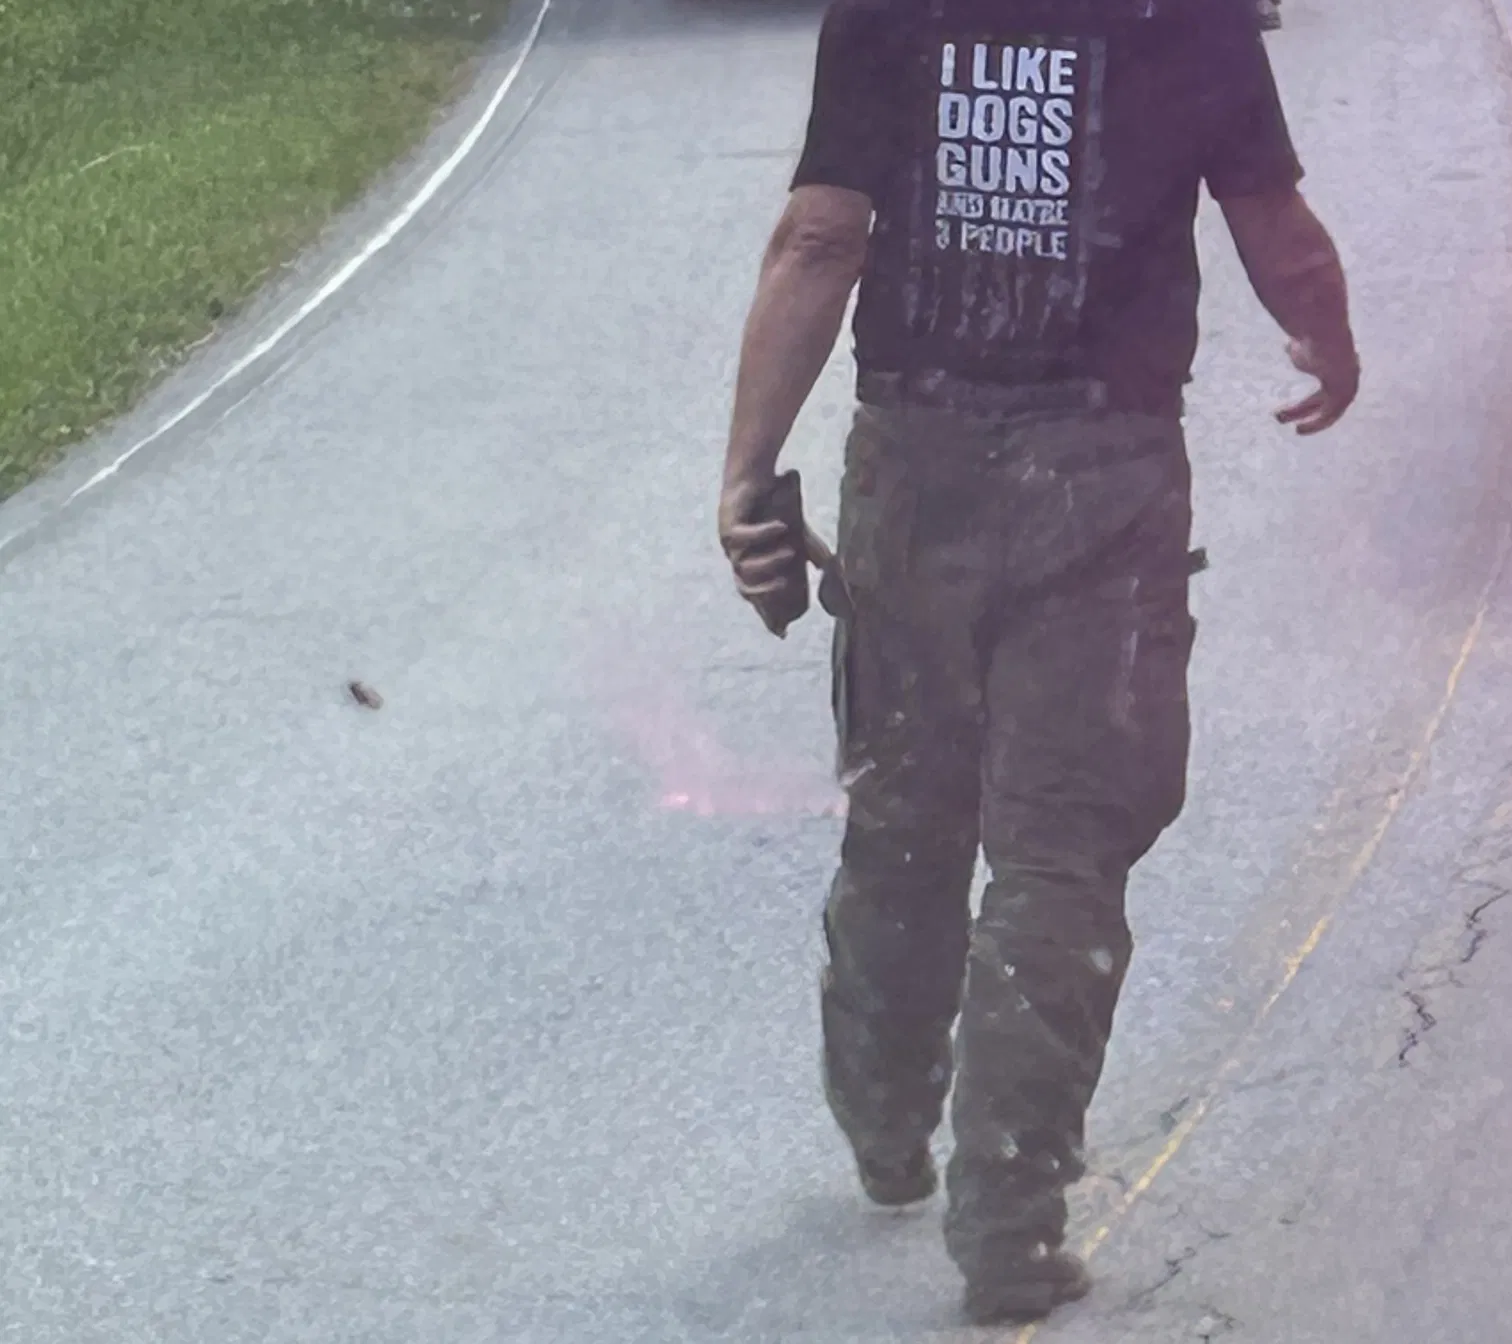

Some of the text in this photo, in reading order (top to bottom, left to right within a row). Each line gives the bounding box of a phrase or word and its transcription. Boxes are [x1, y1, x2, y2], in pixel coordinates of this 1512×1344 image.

[941, 43, 1077, 95] I LIKE
[938, 92, 1073, 146] DOGS
[936, 142, 1070, 196] GUNS
[961, 221, 1068, 260] PEOPLE
